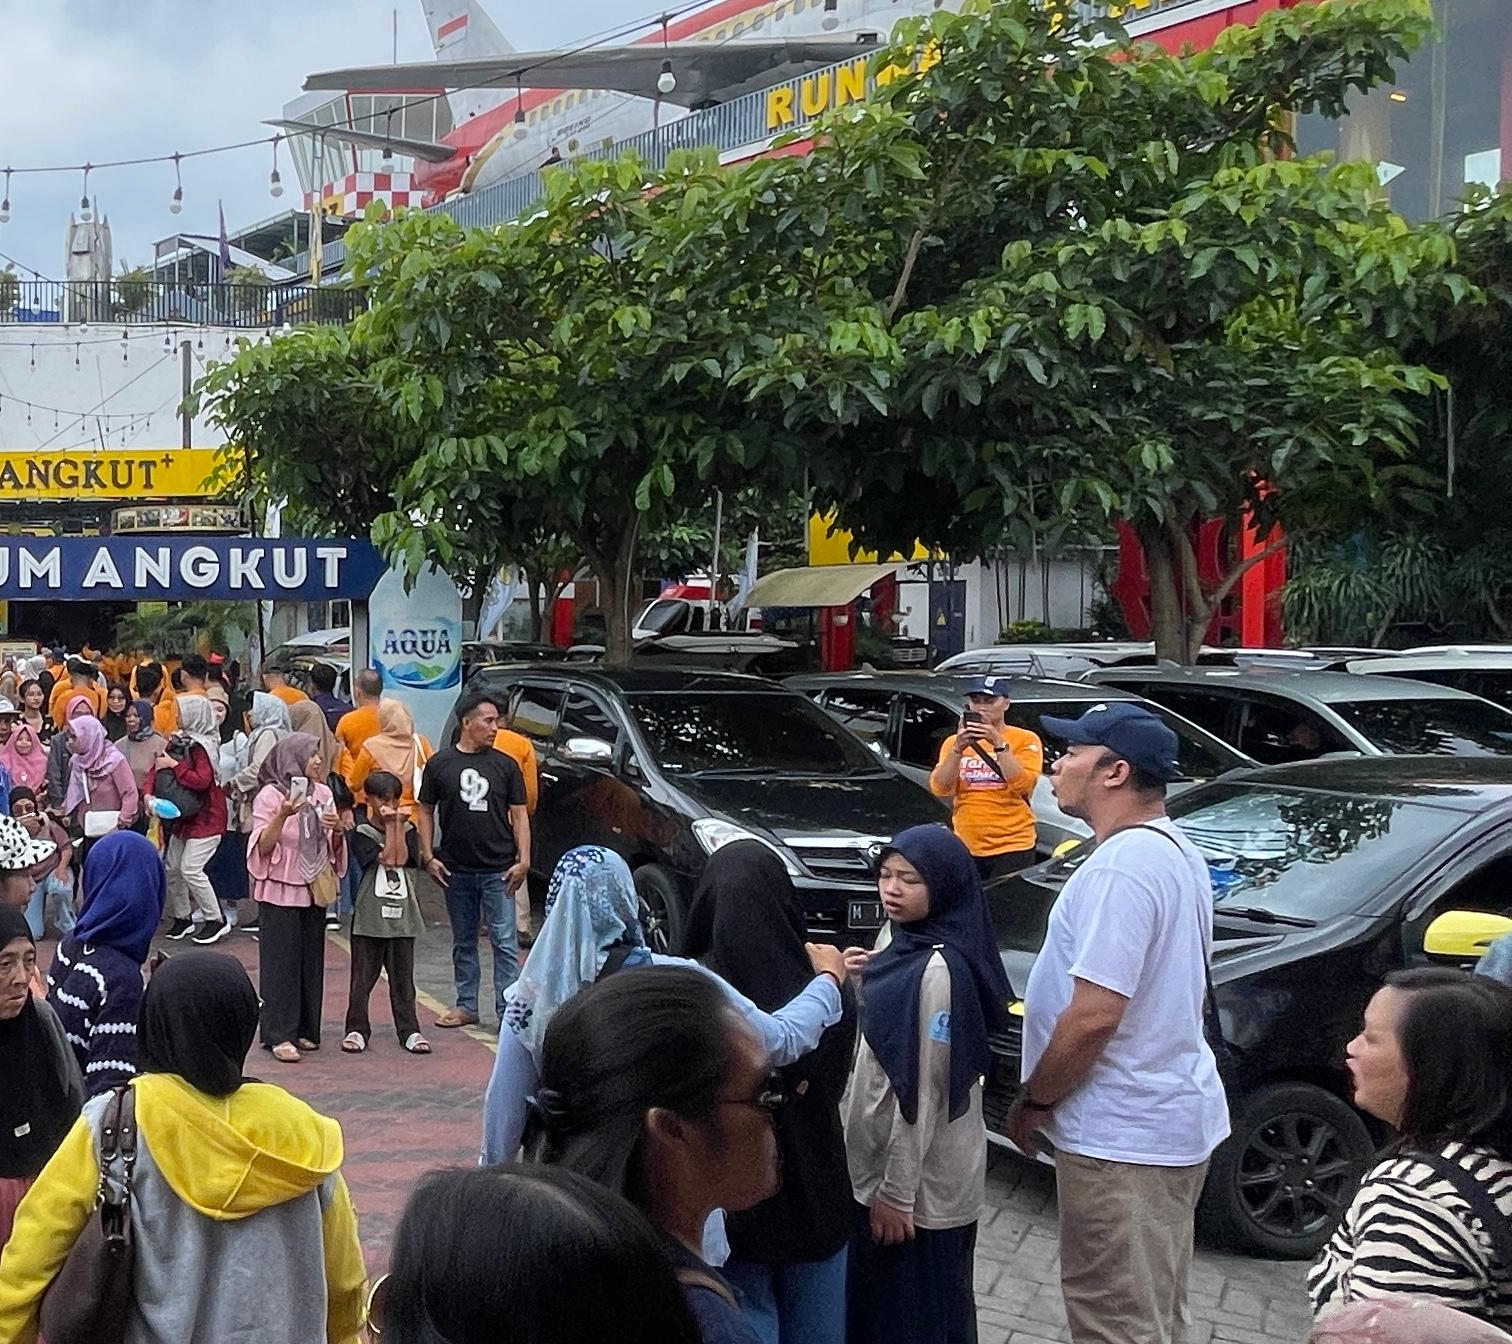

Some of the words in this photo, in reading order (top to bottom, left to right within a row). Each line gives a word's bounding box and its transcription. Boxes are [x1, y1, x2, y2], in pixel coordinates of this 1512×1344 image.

[766, 37, 944, 130] RUN
[81, 545, 348, 590] ANGKUT
[381, 628, 453, 659] AQUA
